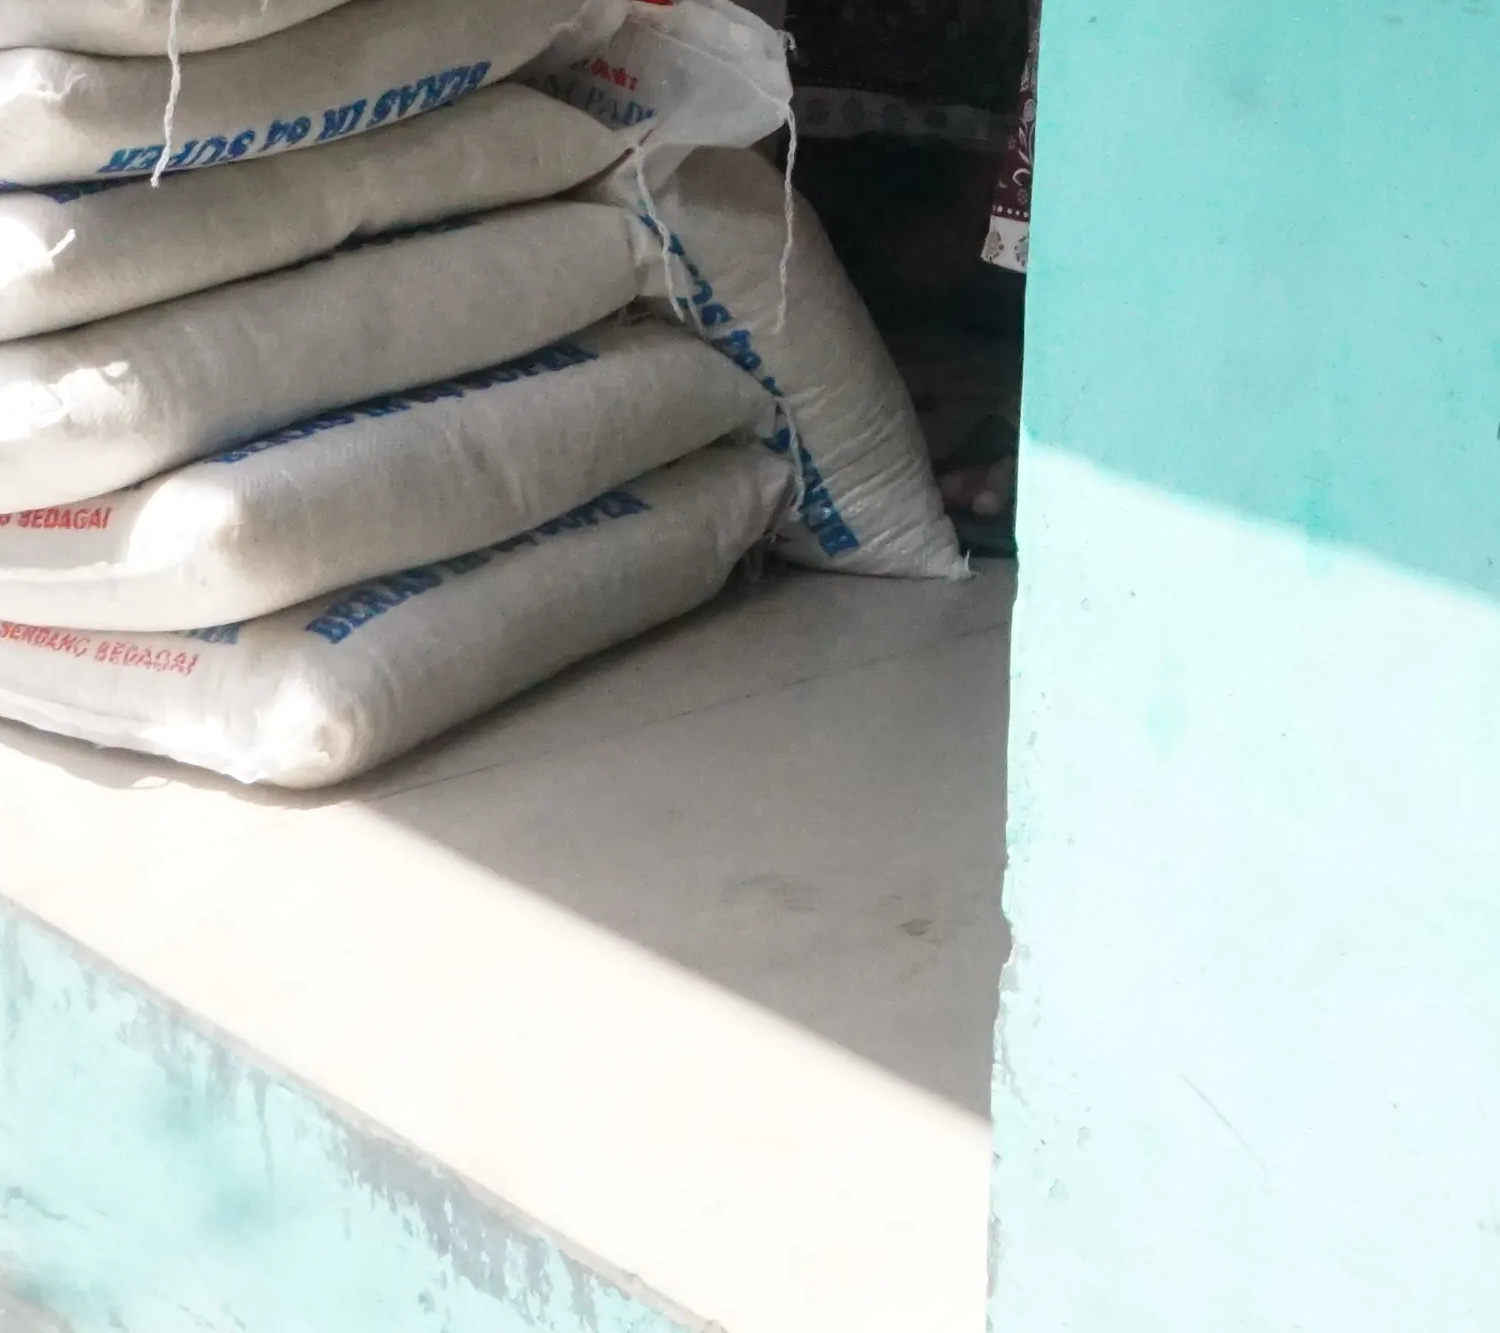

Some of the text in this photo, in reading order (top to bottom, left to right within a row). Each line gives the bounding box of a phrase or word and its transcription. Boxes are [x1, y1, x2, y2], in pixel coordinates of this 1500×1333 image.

[366, 60, 492, 129] BERAS
[97, 128, 257, 173] SUPER
[258, 115, 312, 152] 64
[16, 506, 113, 530] BEDAGAI
[93, 639, 202, 677] BEDAGAI
